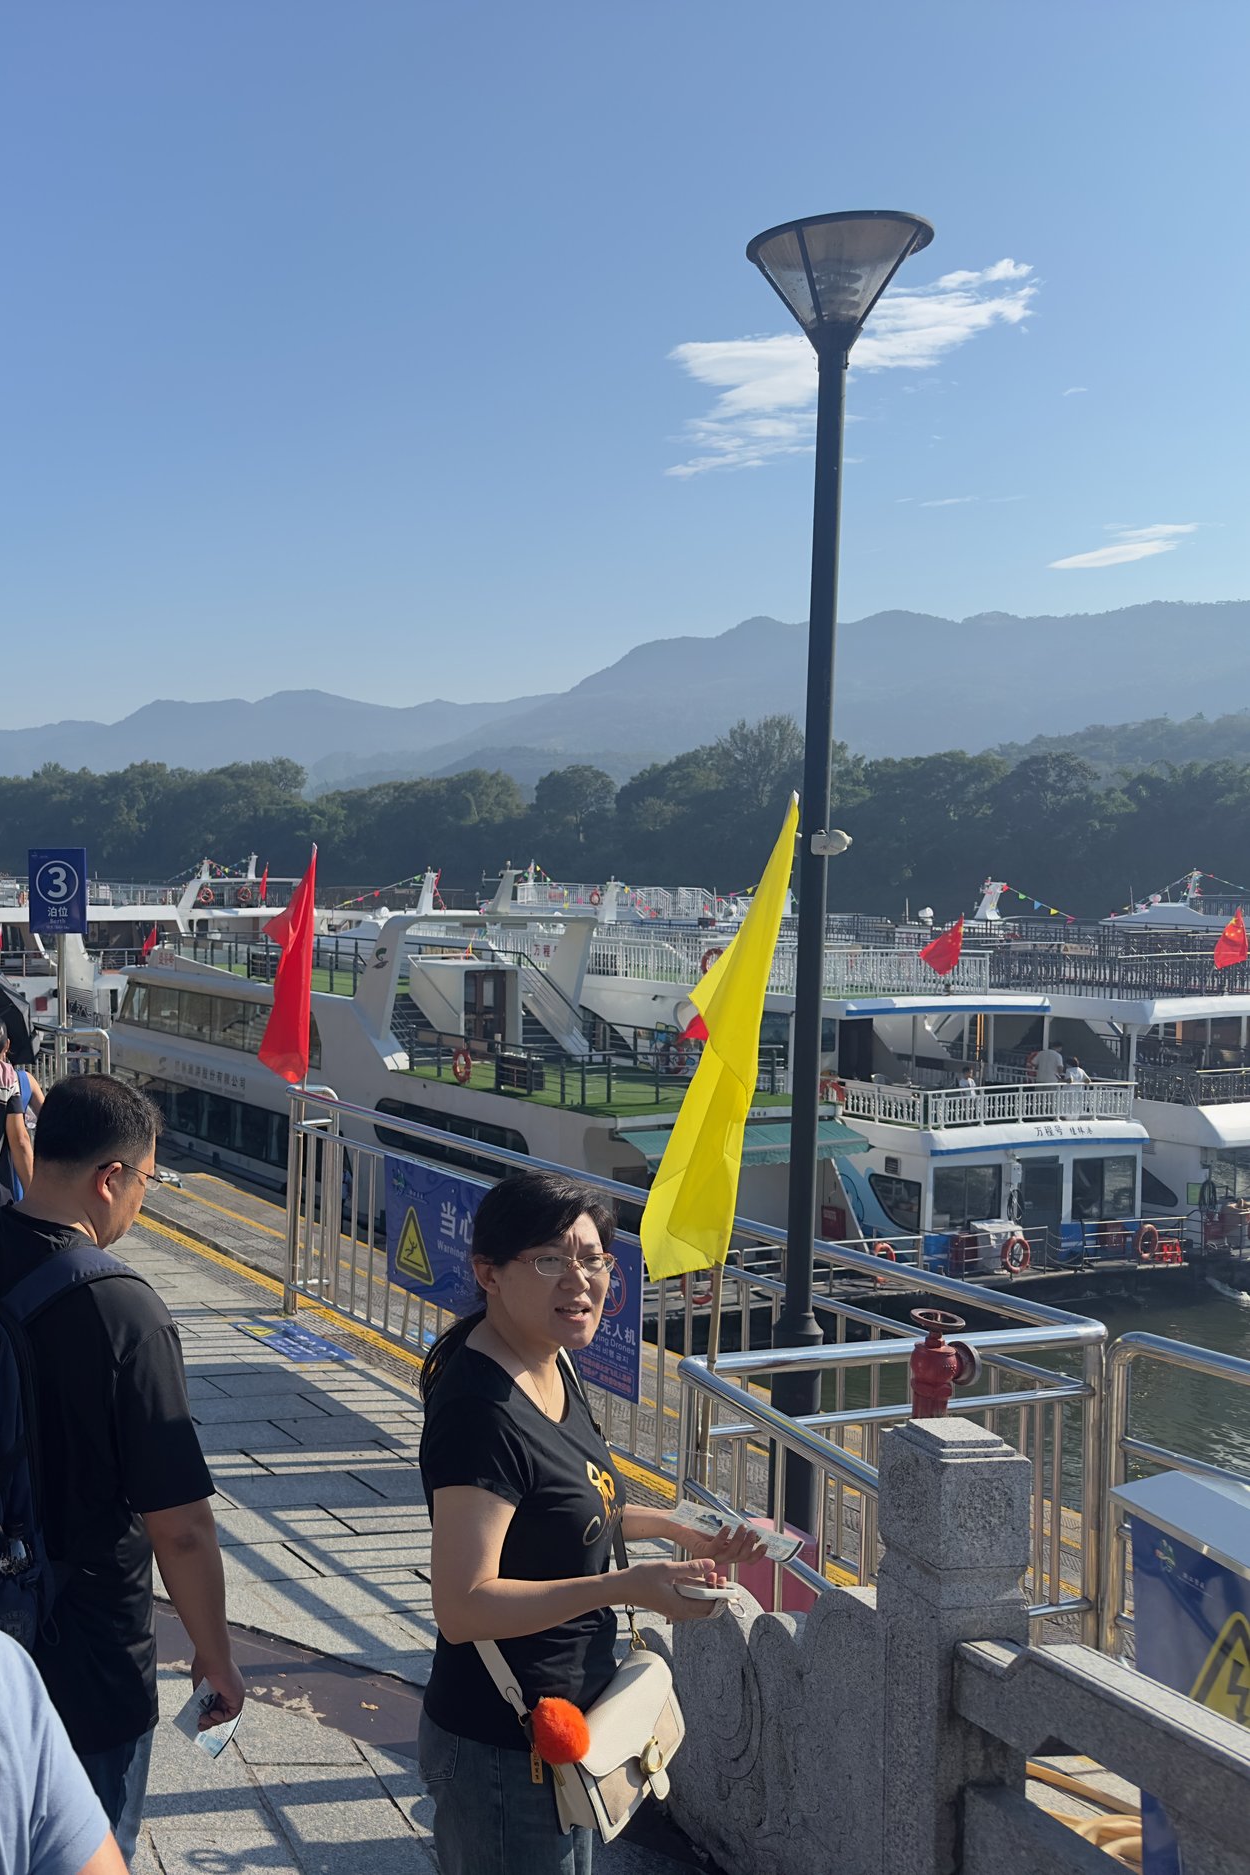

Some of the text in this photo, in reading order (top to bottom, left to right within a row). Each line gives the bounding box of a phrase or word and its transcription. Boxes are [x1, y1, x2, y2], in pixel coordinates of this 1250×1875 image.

[47, 866, 68, 898] 3
[47, 906, 69, 917] 泊位
[1034, 1125, 1063, 1137] 万程号
[600, 1317, 636, 1346] 无人机
[610, 1340, 635, 1356] Drones
